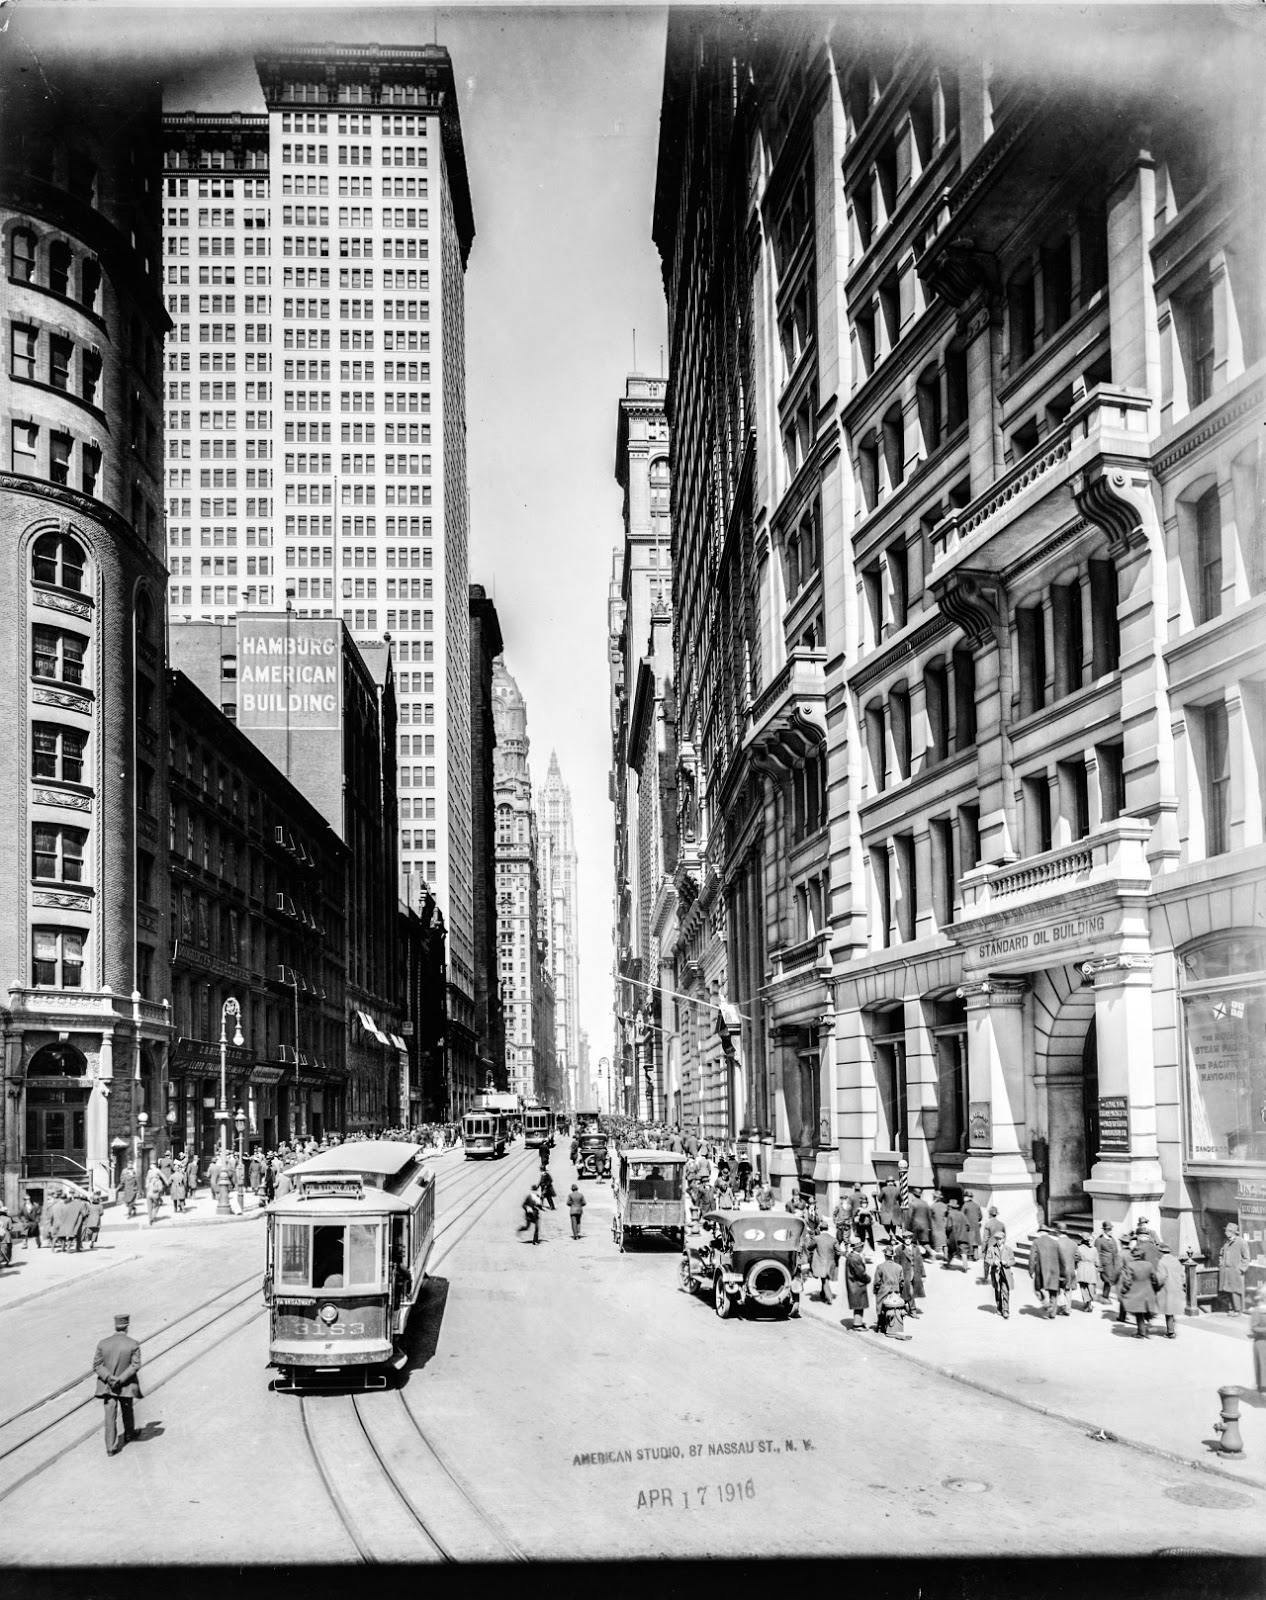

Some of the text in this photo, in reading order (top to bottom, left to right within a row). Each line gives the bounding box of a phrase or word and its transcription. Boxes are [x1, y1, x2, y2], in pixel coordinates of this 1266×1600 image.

[243, 636, 335, 656] HAMBURG
[241, 665, 337, 683] AMERICAN
[243, 693, 337, 712] BUILDING
[979, 916, 1105, 958] STANDARD OIL BUILDING
[1194, 1044, 1220, 1056] STEAM
[294, 1322, 365, 1336] 3153
